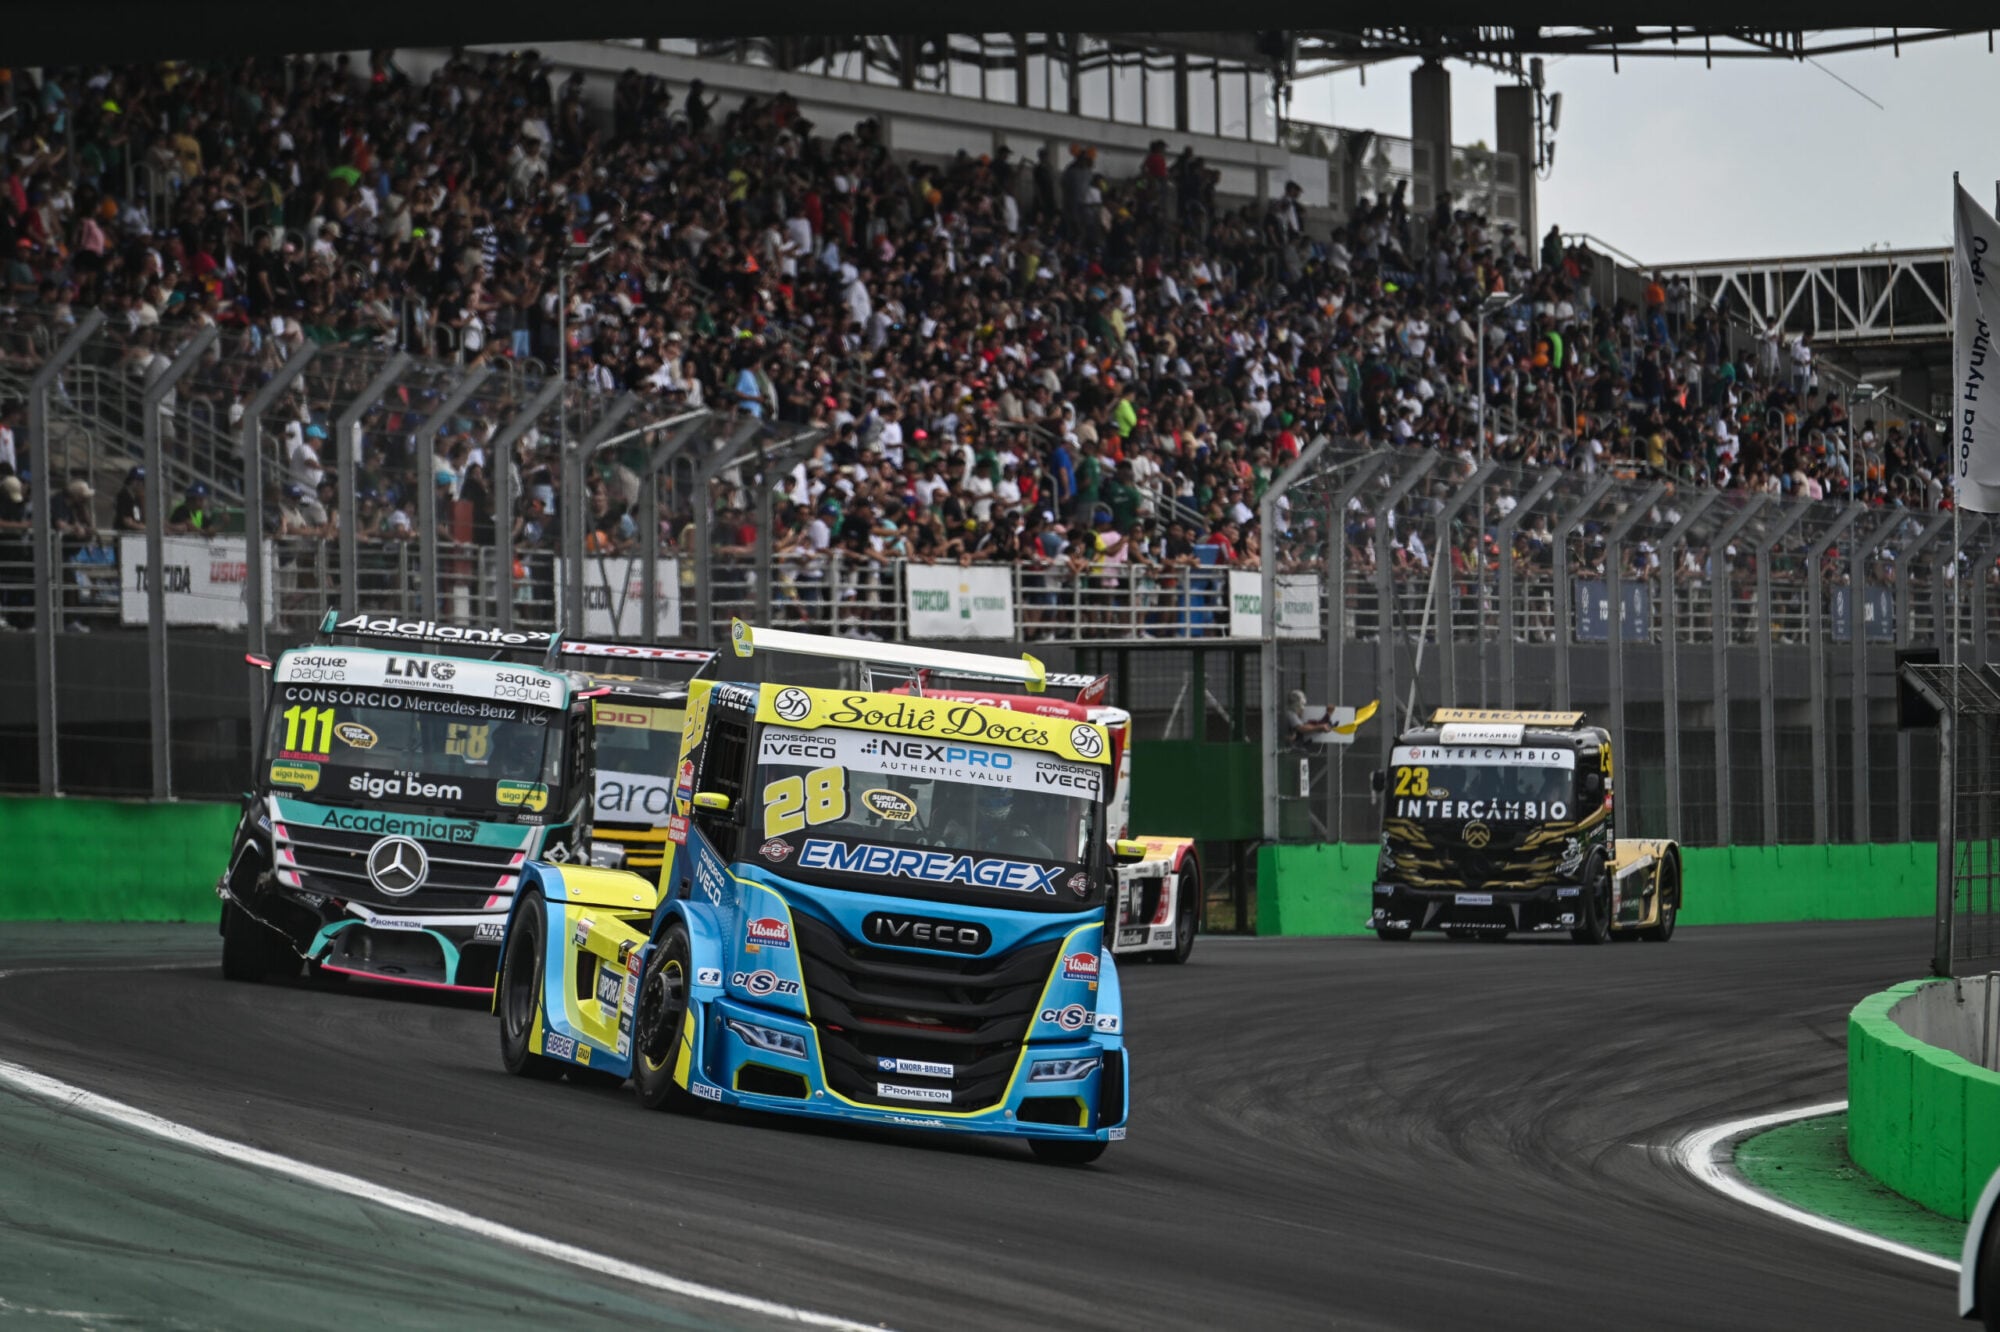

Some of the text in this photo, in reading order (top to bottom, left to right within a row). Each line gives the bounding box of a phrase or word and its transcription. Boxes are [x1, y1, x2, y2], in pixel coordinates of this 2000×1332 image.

[337, 614, 528, 644] Addiante
[385, 657, 456, 680] LNG
[384, 678, 454, 690] AUTOMOTIVE PARTS
[285, 687, 401, 708] CONSÓRCIO
[404, 696, 516, 720] Mercedes-Benz
[283, 705, 335, 754] 111
[829, 696, 1049, 746] Sodiê Doces
[764, 732, 836, 745] CONSÓRCIO
[763, 744, 836, 760] IVECO
[881, 739, 1012, 770] NEXPRO
[275, 769, 313, 780] siga bem
[394, 770, 420, 778] REDE
[880, 761, 1013, 783] AUTHENTIC VALUE
[1035, 771, 1101, 792] IVECO
[1394, 766, 1429, 796] 23
[349, 772, 462, 800] siga bem
[763, 766, 847, 839] 28
[872, 793, 896, 804] SUPER
[875, 800, 907, 811] TRUCK
[322, 809, 448, 838] Academia
[518, 814, 542, 822] ACROSS
[886, 810, 910, 820] PRO
[797, 839, 1065, 895] EMBREAGEX
[696, 861, 721, 907] IVECO
[748, 920, 787, 938] Usual
[875, 917, 979, 945] IVECO
[750, 937, 786, 946] BRINQUEDOS
[1063, 957, 1097, 973] Usual
[732, 972, 800, 994] CISER
[900, 1062, 952, 1075] KNORR-BREMSE
[694, 1084, 721, 1099] MAHLE
[884, 1085, 949, 1098] PROMETEON
